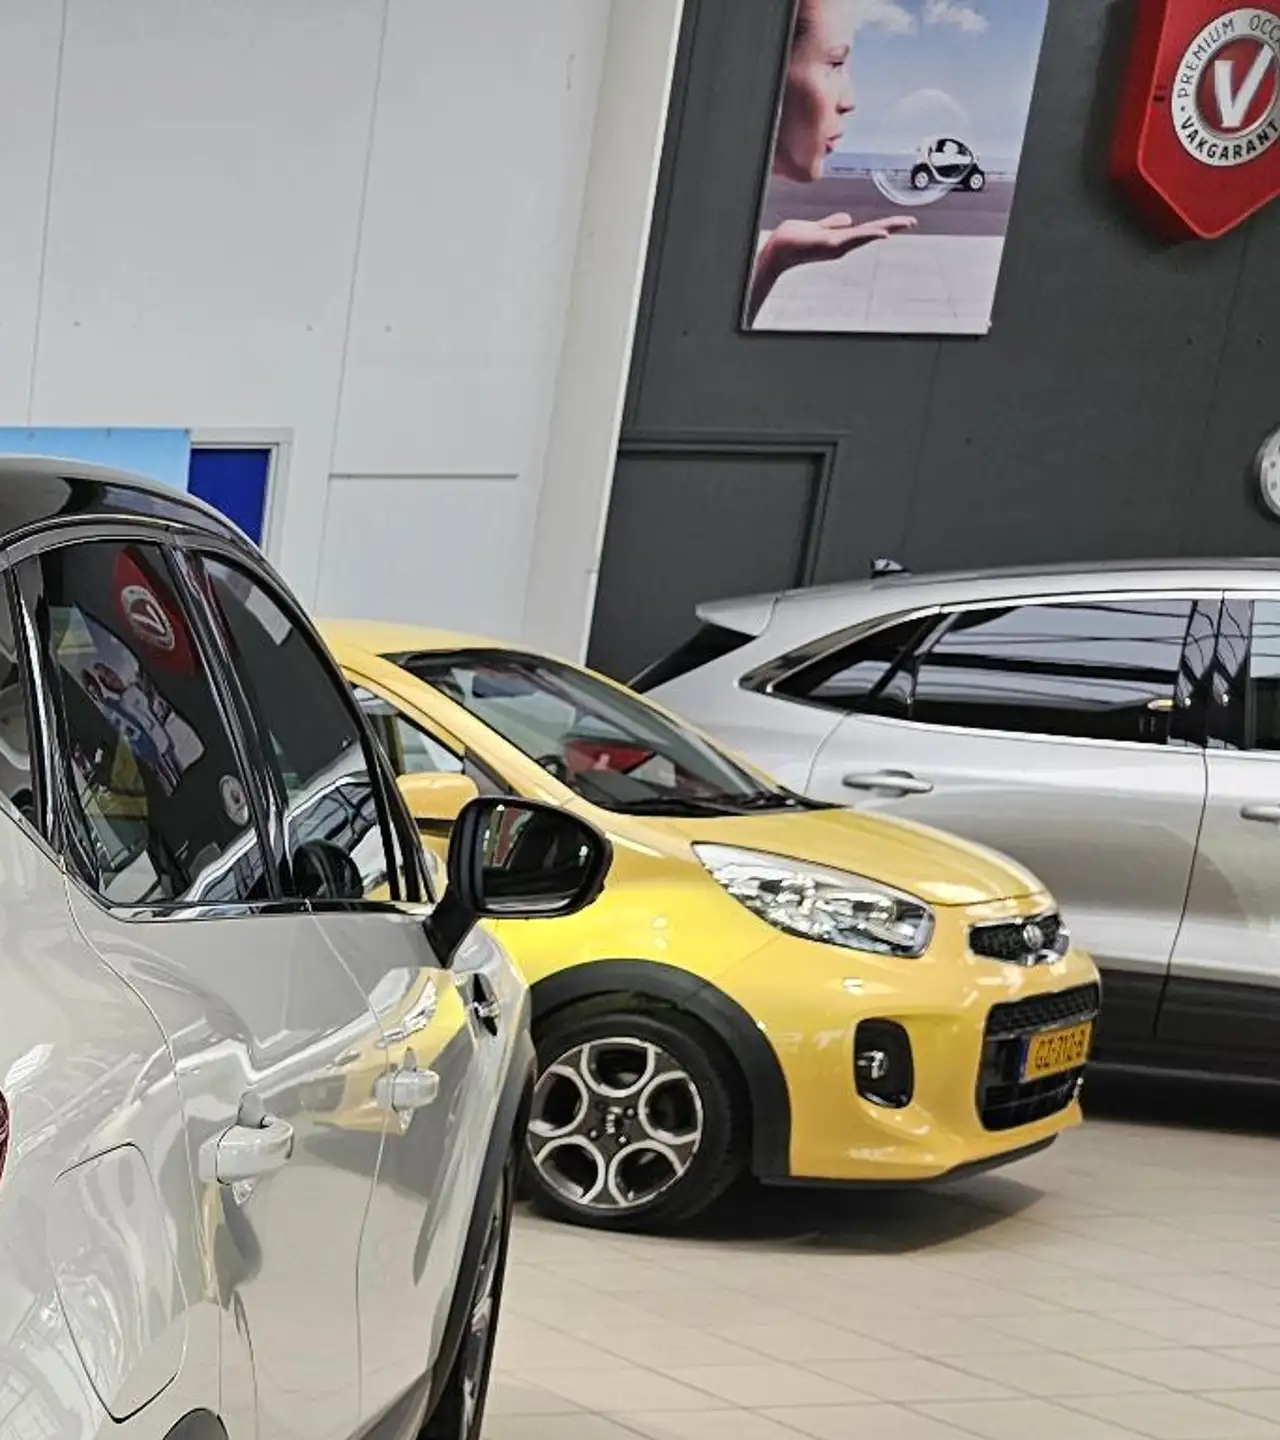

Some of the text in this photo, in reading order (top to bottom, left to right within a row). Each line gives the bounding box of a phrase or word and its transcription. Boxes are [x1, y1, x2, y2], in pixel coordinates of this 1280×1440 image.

[1177, 18, 1235, 99] PREMIUM
[1214, 46, 1274, 128] V
[1180, 114, 1279, 161] VAKGARANT
